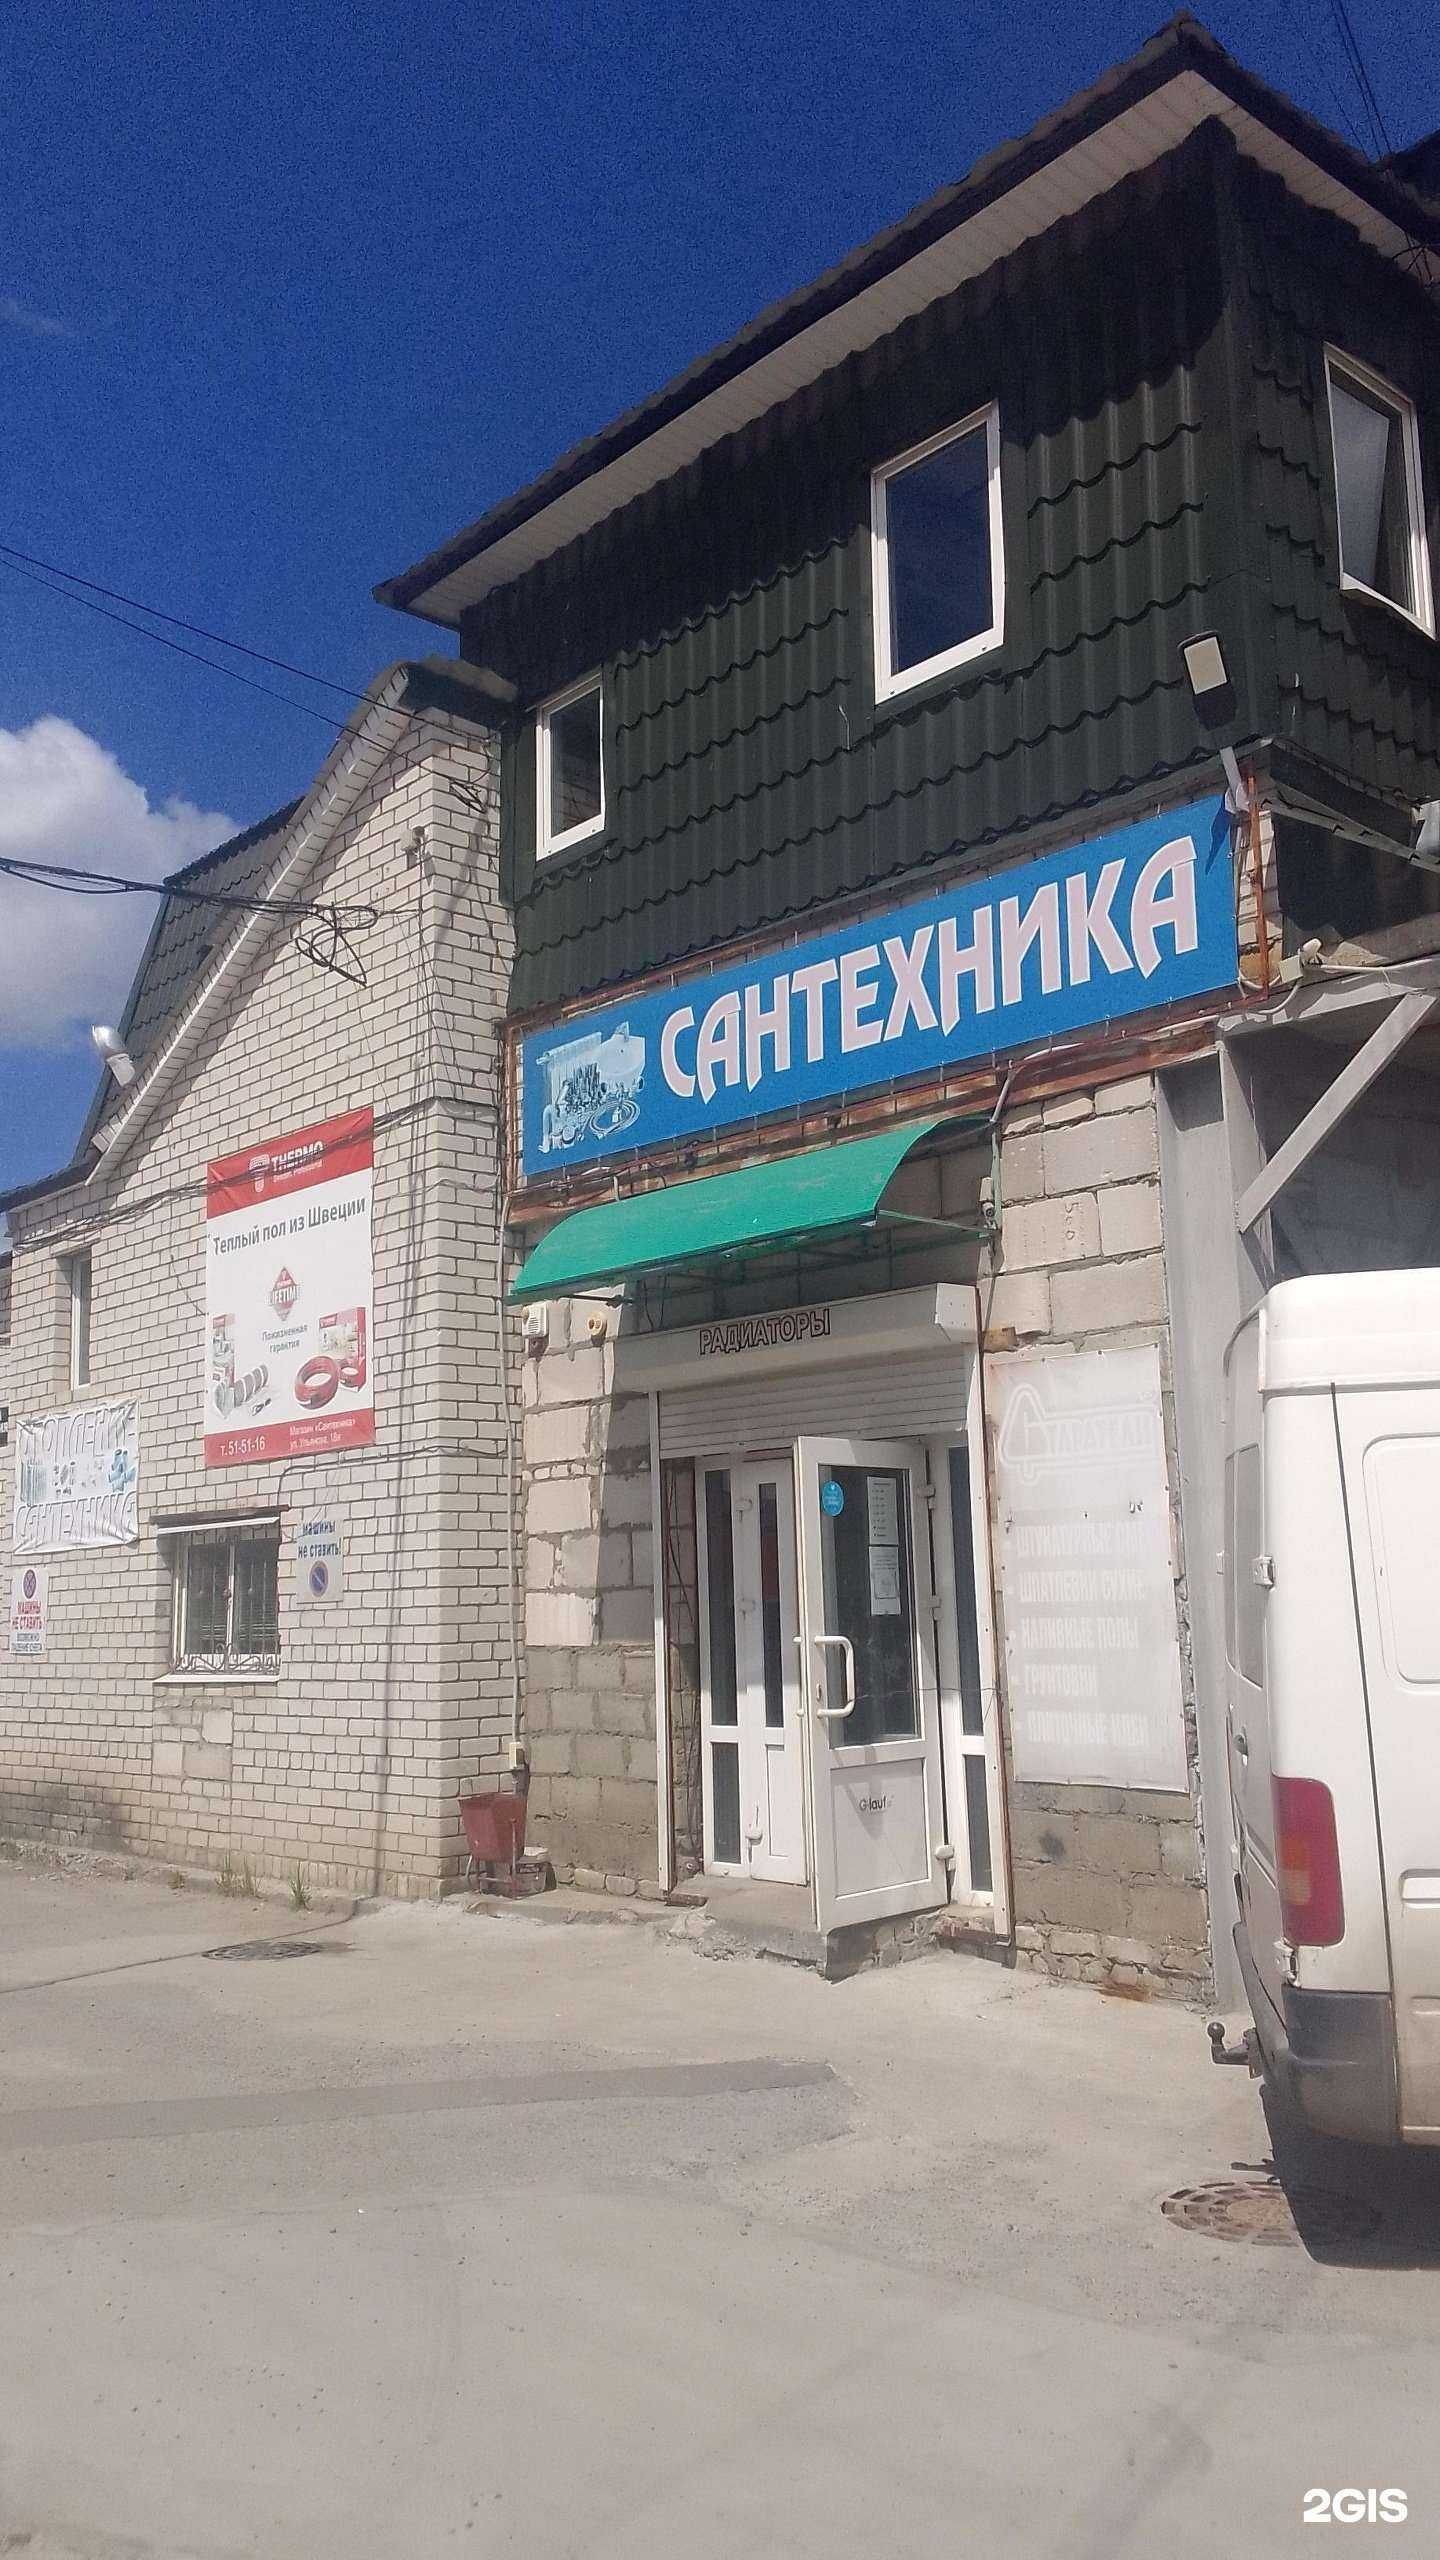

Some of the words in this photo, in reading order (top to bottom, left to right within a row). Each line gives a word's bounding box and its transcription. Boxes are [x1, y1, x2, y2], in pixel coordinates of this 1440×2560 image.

[660, 835, 1198, 1105] САНТЕХНИКА
[213, 1226, 260, 1256] Теплый
[263, 1221, 286, 1242] пол
[289, 1216, 305, 1234] из
[308, 1198, 365, 1229] Швеции
[700, 1308, 831, 1355] РАДИАТОРЫ
[298, 1544, 308, 1558] не
